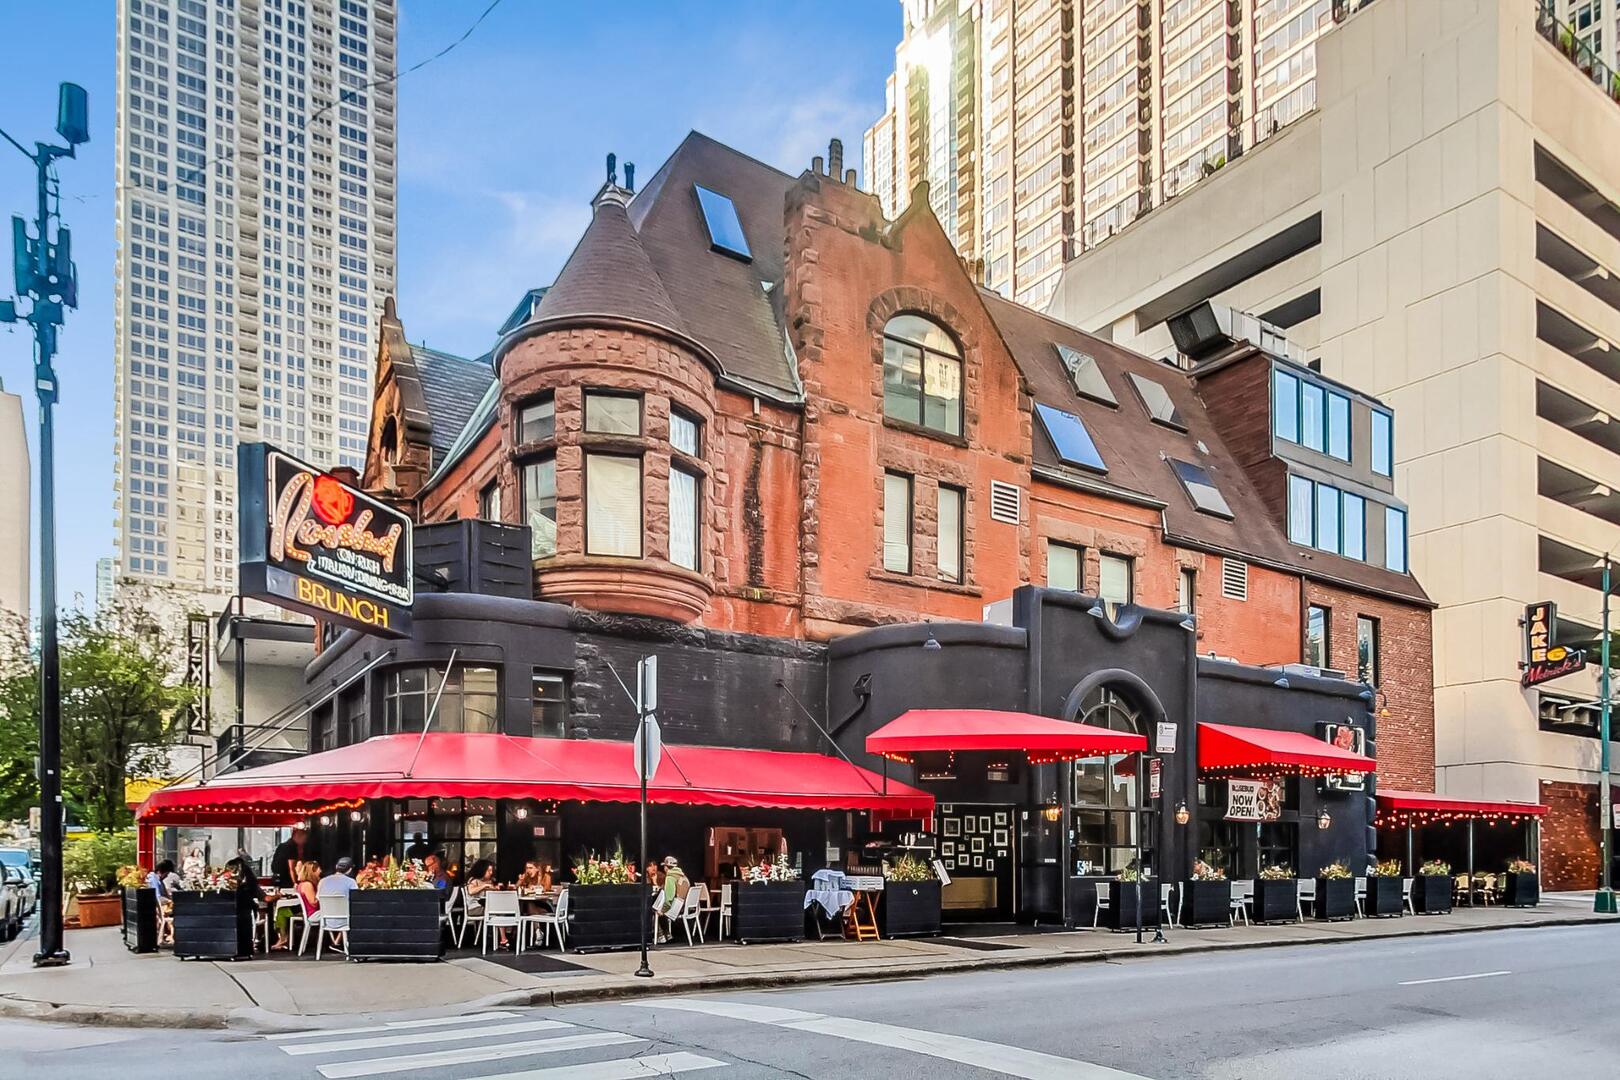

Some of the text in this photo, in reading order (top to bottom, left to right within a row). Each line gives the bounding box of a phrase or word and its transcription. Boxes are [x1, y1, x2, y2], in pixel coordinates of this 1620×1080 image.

[270, 472, 402, 573] Rosebud
[317, 555, 355, 580] ITALIAN
[298, 577, 388, 629] BRUNCH
[1530, 607, 1548, 662] JAKE
[1230, 806, 1255, 817] OPEN!
[1232, 794, 1254, 806] NOW
